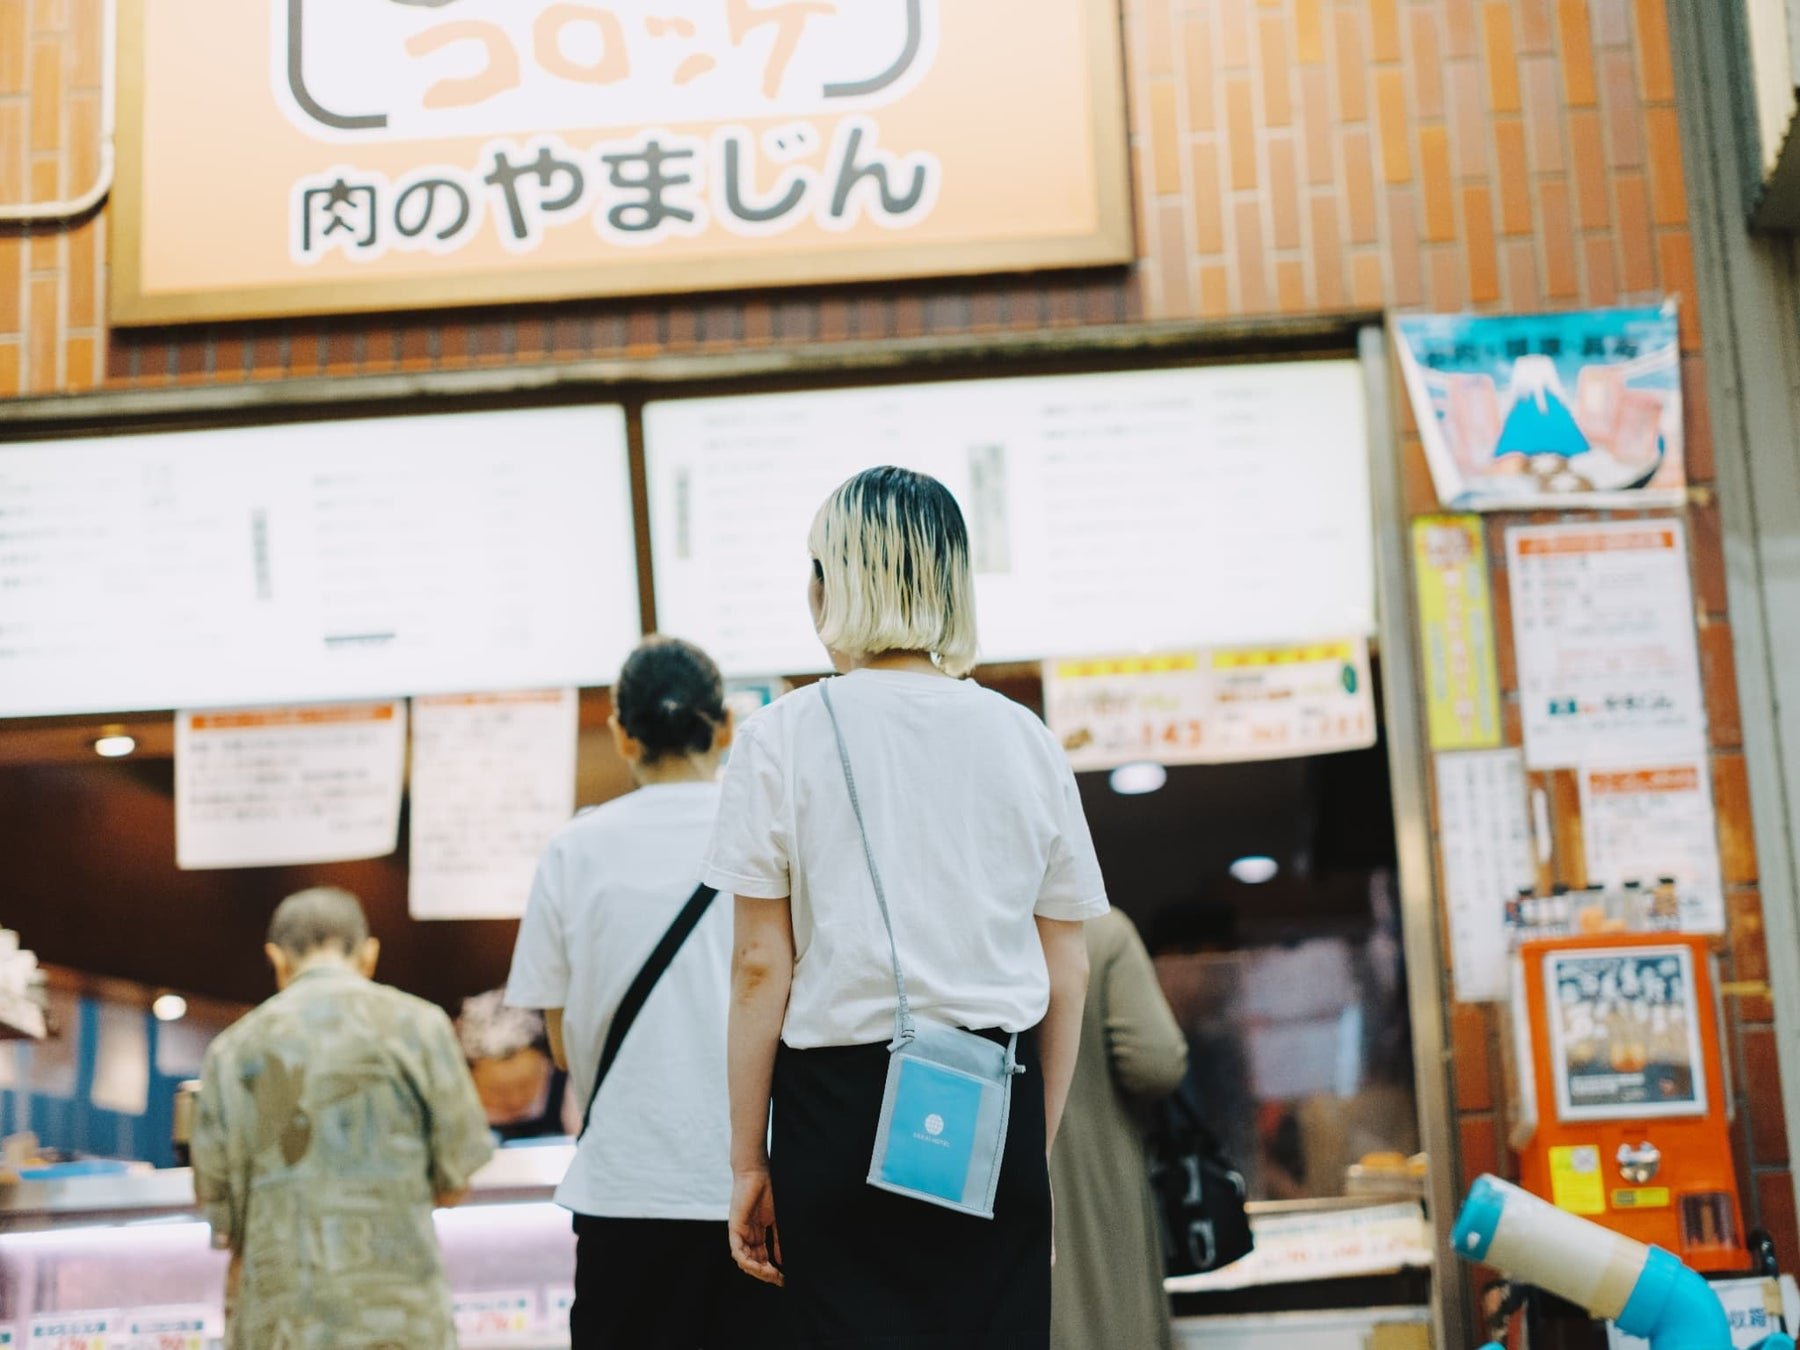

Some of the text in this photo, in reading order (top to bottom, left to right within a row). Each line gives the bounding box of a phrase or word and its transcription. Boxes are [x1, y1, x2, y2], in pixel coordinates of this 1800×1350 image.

[405, 0, 837, 109] コロッケ
[302, 128, 927, 251] 肉のやまじん
